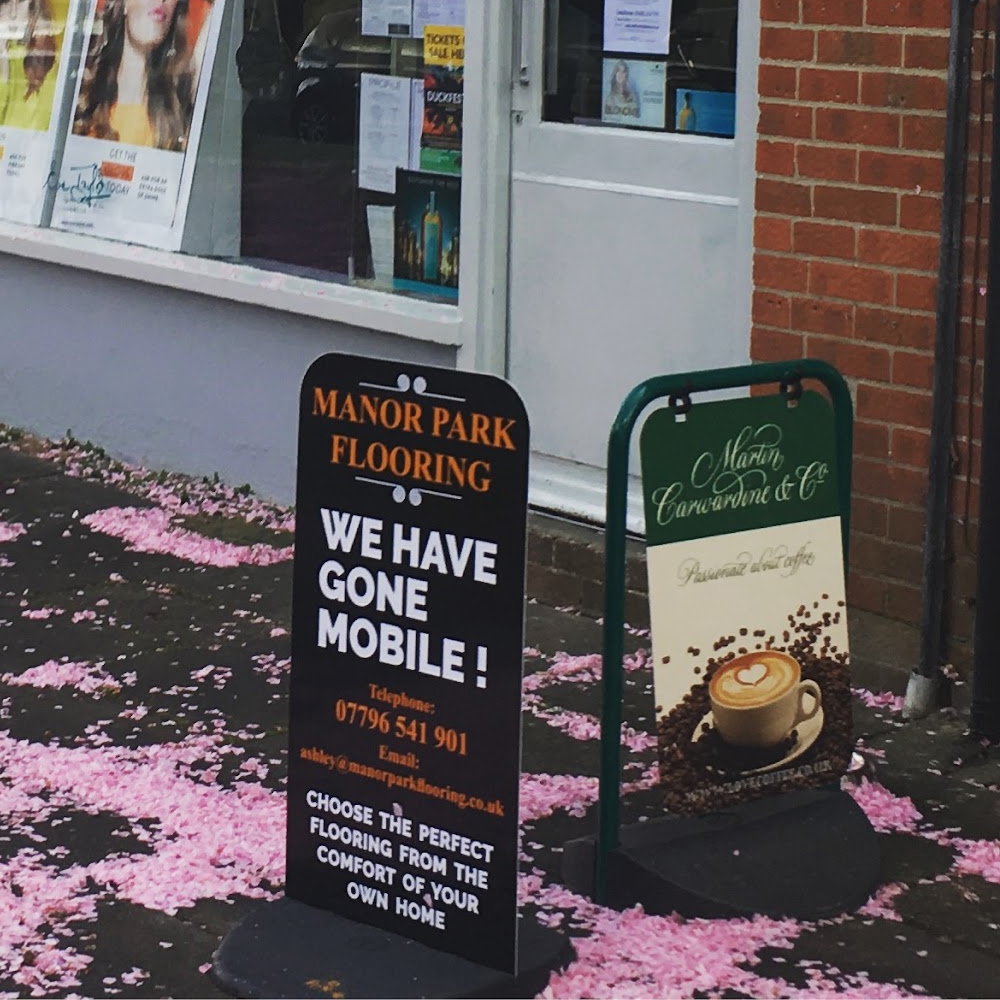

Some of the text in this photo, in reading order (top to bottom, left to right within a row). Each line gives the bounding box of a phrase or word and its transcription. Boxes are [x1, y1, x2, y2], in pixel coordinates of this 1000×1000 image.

[106, 180, 131, 195] TODAY
[311, 387, 518, 450] MANOR PARK
[330, 434, 492, 493] FLOORING
[691, 423, 785, 489] Martin
[652, 469, 772, 526] Carwardine
[774, 474, 794, 502] &
[320, 508, 498, 585] WE HAVE
[677, 540, 816, 587] Passionate about coffee
[318, 560, 428, 622] GONE
[317, 608, 466, 683] MOBILE
[335, 699, 468, 756] 07796 541 901
[368, 683, 435, 715] Telephone:
[300, 747, 505, 817] ashley@manorparkflooring.co.uk
[379, 745, 420, 770] Email:
[306, 790, 494, 863] CHOOSE THE PERFECT
[310, 817, 489, 890] FLOORING FROM THE
[317, 846, 479, 914] COMFORT OF YOUR
[347, 882, 445, 930] OWN HOME
